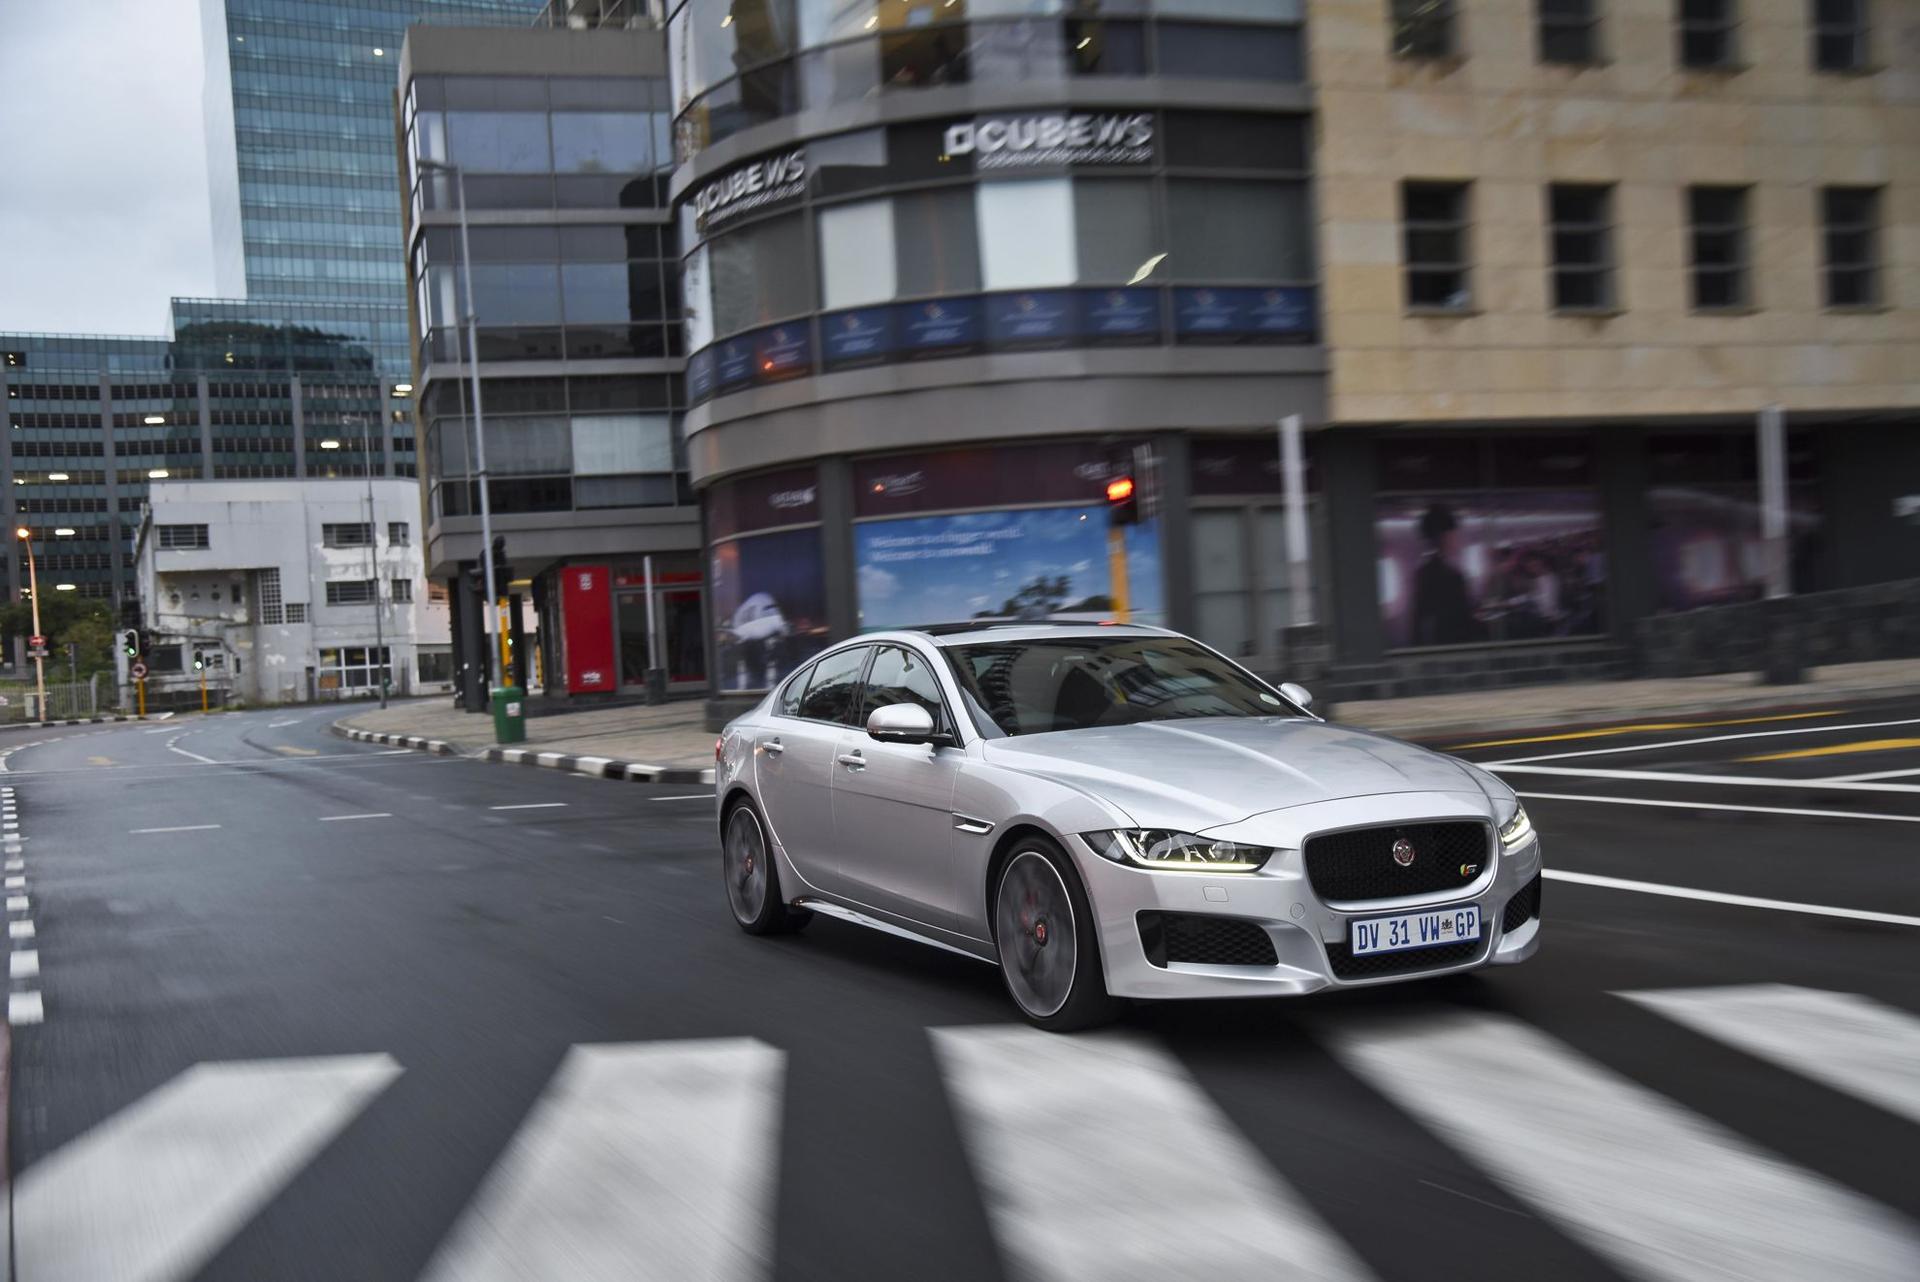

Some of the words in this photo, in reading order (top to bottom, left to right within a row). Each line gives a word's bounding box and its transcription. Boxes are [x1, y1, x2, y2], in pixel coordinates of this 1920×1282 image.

[1358, 923, 1379, 950] DV
[1389, 920, 1410, 946] 31
[1419, 915, 1440, 942] VW
[1456, 911, 1475, 937] GP
